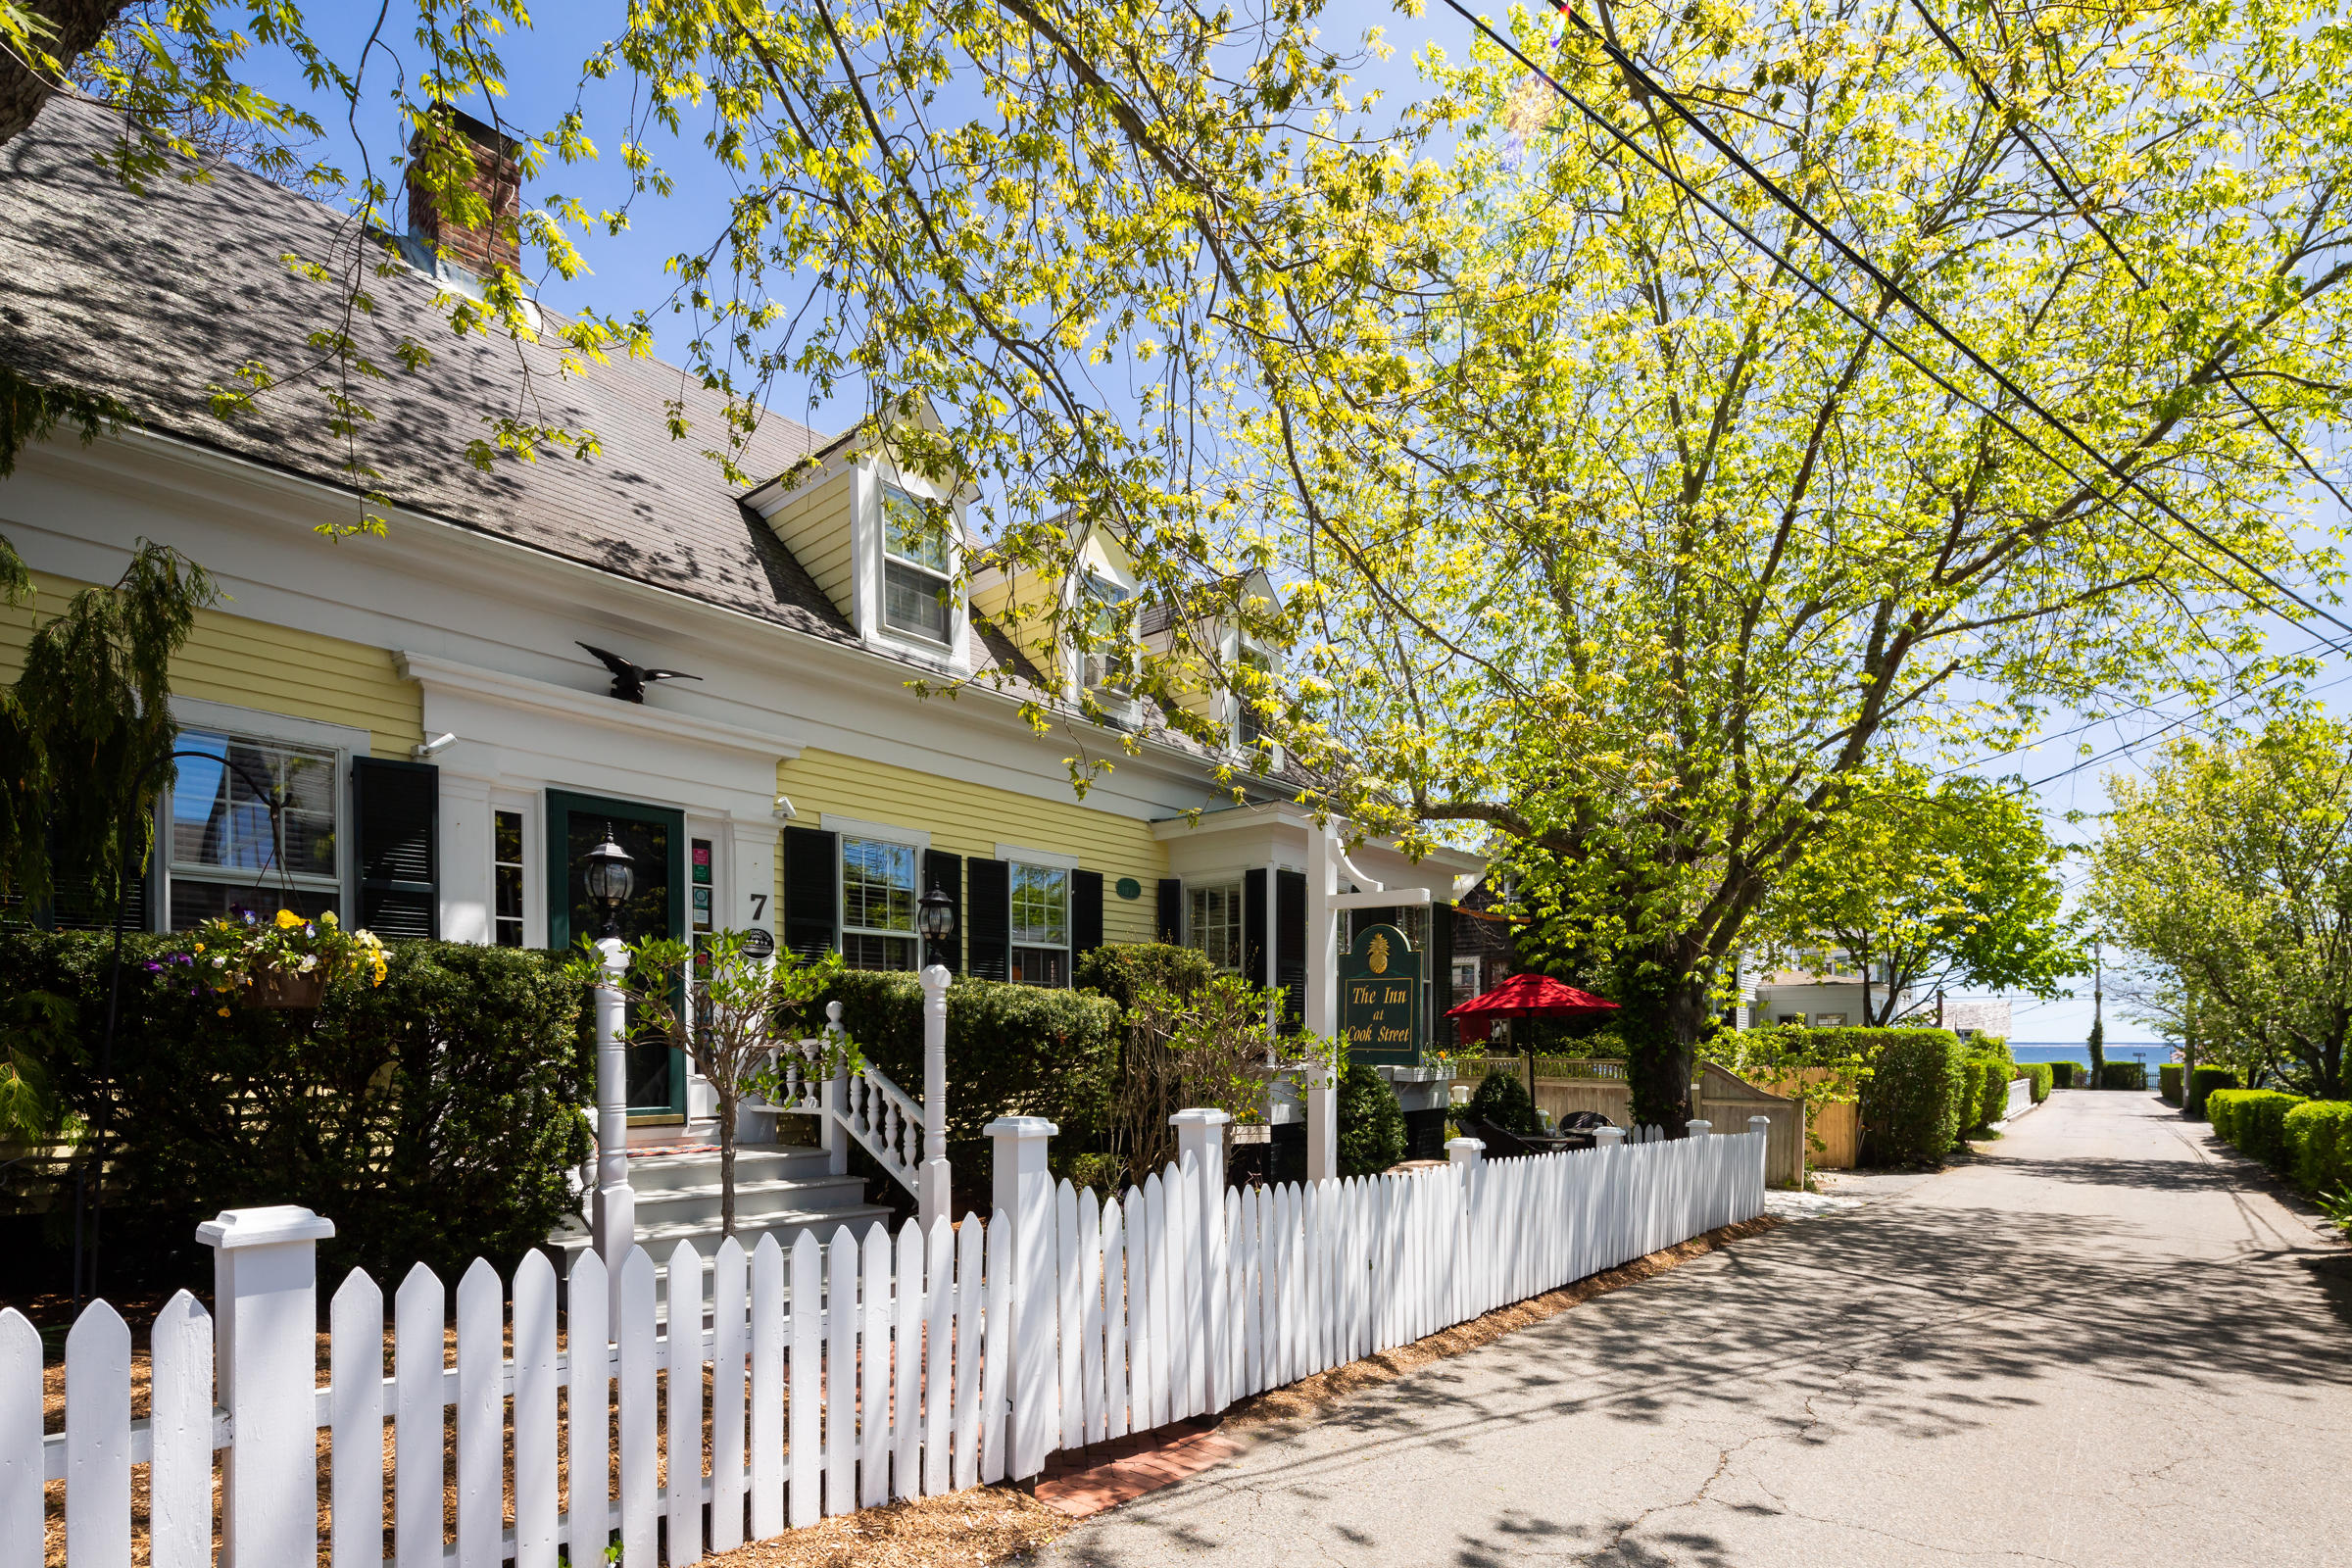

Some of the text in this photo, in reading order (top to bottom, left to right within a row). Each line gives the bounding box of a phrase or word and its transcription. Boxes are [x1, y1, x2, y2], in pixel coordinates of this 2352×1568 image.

[750, 893, 768, 921] 7
[1352, 984, 1407, 1004] The Inn
[1373, 1008, 1385, 1021] at
[1347, 1023, 1409, 1043] Cook Street
